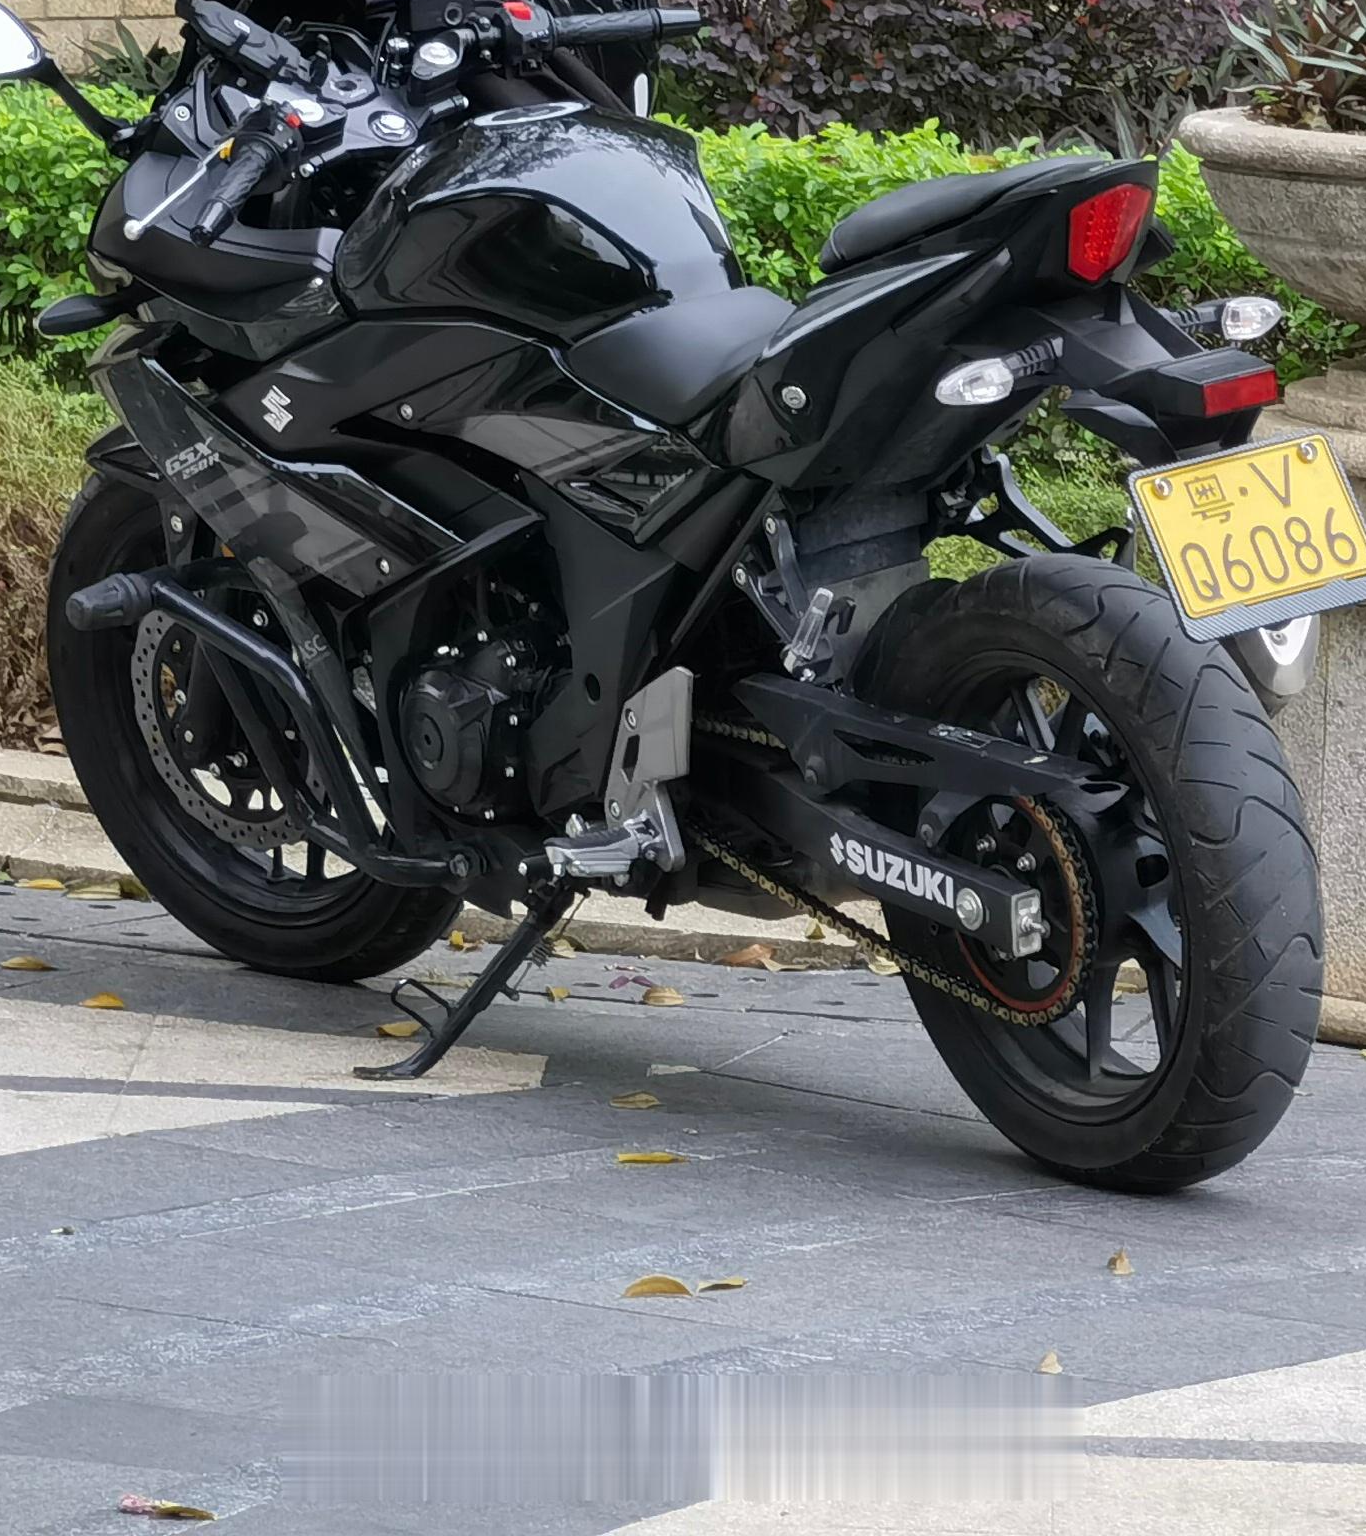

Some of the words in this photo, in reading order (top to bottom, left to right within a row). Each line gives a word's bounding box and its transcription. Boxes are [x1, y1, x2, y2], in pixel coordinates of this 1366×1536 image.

[165, 436, 213, 476] GSX
[1180, 506, 1358, 601] Q6086
[845, 838, 955, 909] SUZUKI
